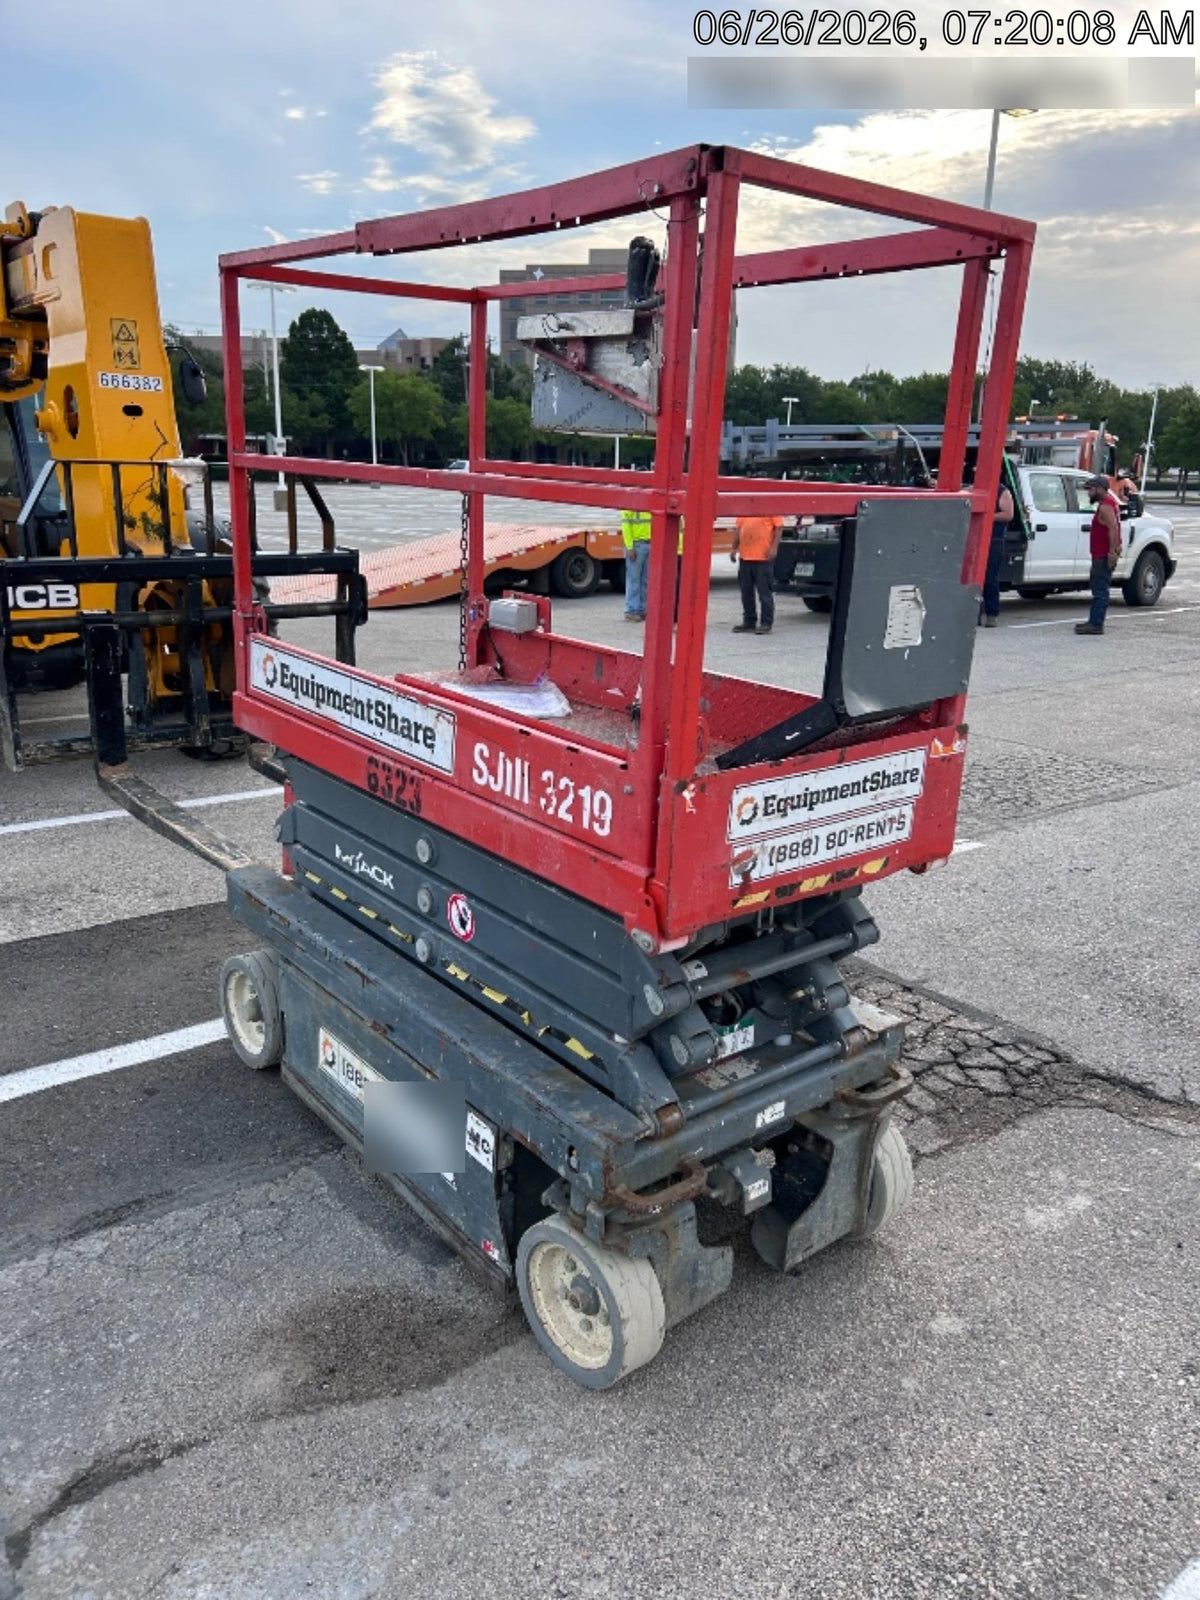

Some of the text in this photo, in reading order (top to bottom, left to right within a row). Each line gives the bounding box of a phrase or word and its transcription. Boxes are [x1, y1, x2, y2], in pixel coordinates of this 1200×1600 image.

[279, 662, 437, 751] EquipmentShare
[472, 742, 613, 837] SJIII 3219
[762, 767, 920, 818] EquipmentShare
[768, 812, 907, 867] (888) 80-RENTS
